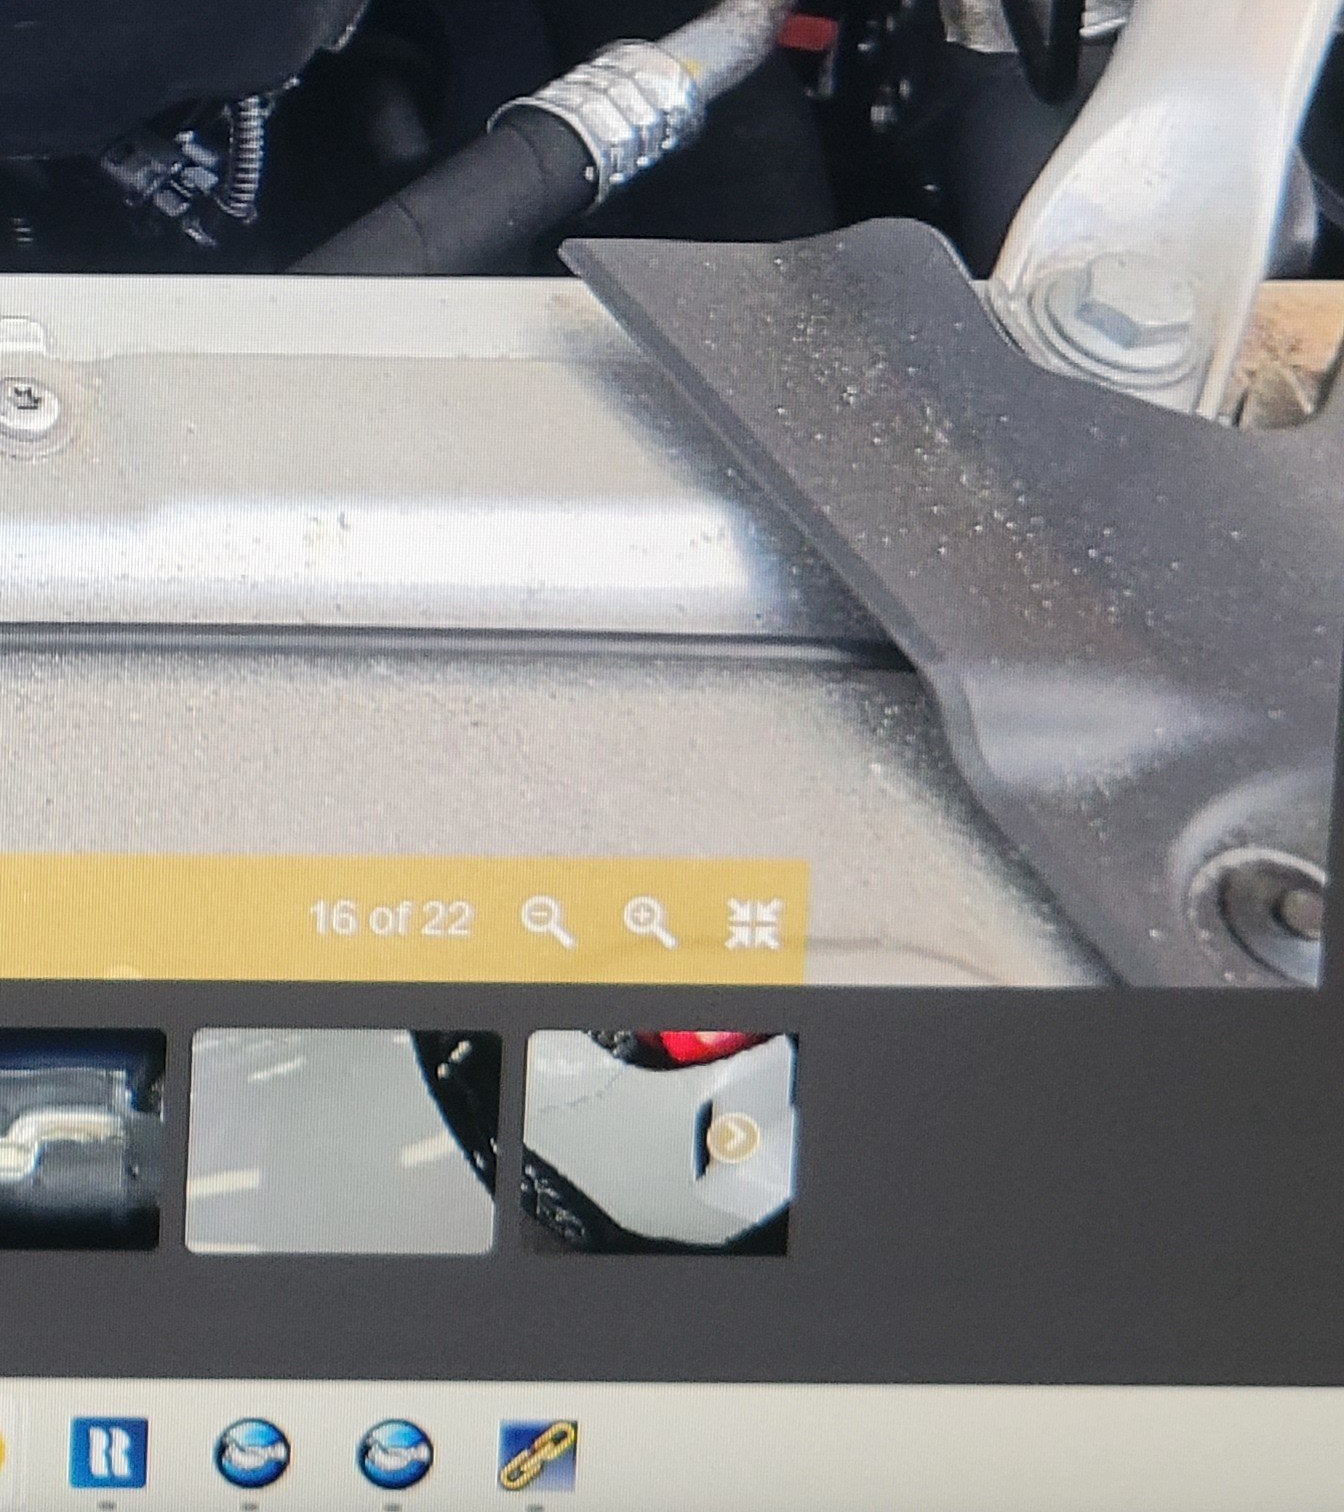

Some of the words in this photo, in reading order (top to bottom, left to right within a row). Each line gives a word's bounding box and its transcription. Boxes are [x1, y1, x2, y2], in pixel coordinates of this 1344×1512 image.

[311, 900, 356, 936] 16
[369, 899, 415, 936] of
[421, 900, 474, 937] 22
